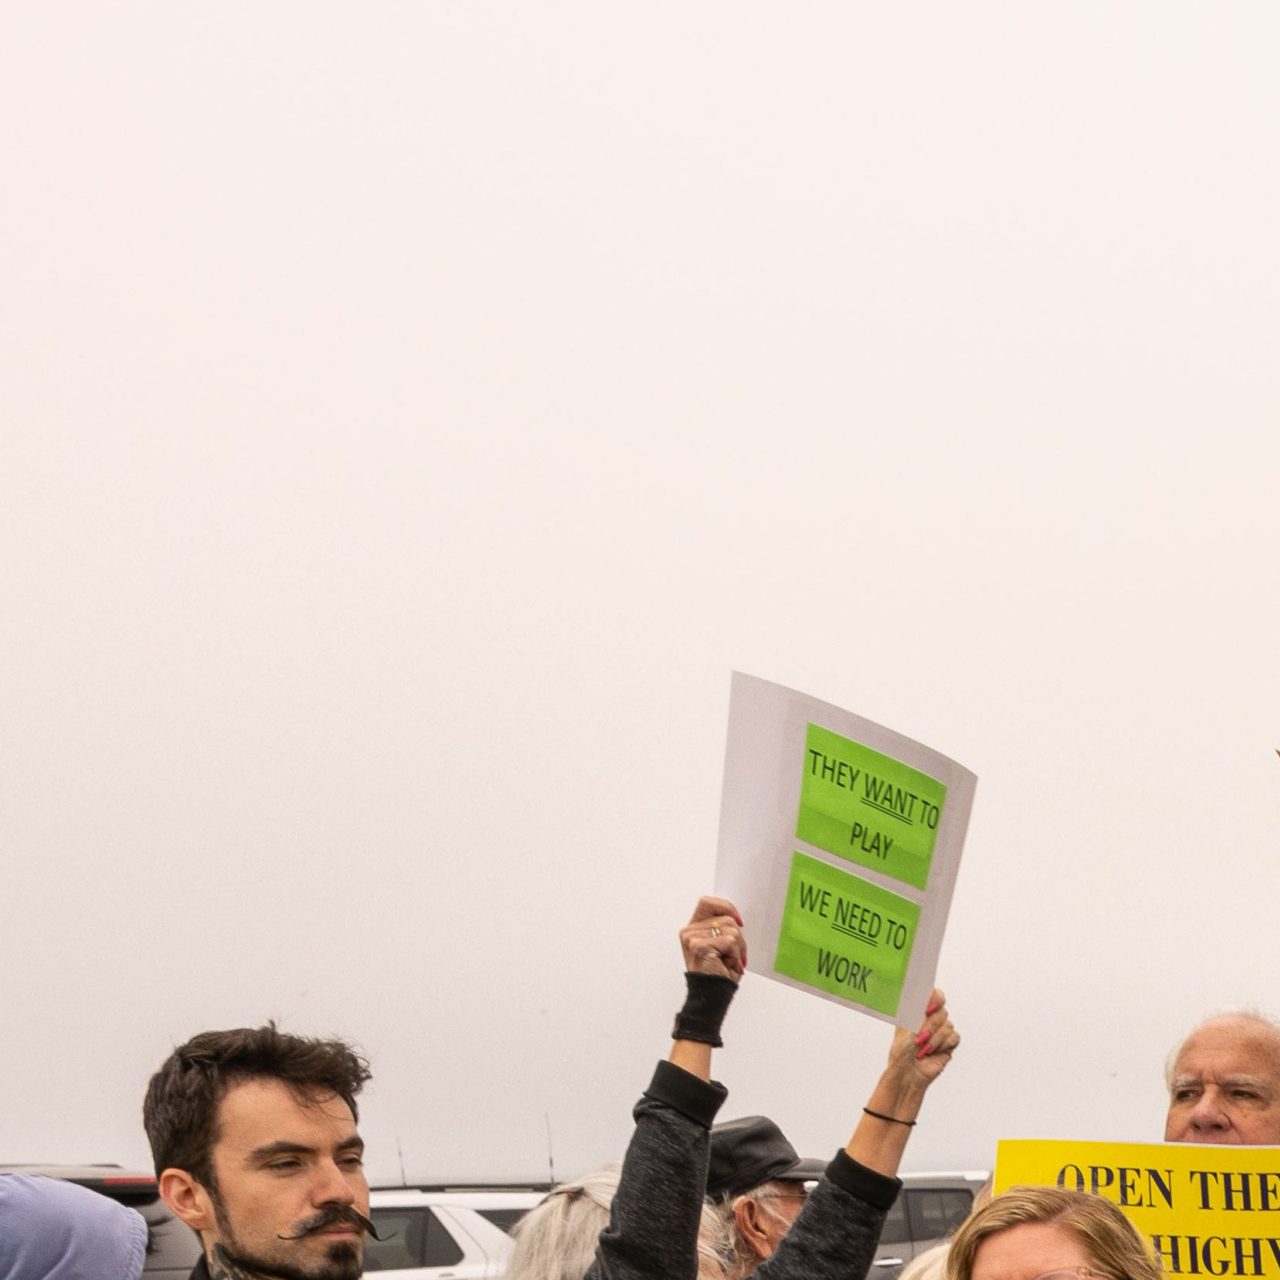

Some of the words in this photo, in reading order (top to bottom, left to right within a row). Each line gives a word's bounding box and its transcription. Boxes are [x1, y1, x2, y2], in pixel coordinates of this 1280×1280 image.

[809, 749, 861, 791] THEY
[864, 773, 918, 819] WANT
[921, 799, 939, 830] TO
[851, 822, 894, 860] PLAY
[800, 881, 831, 919] WE
[835, 897, 881, 941] NEED
[885, 919, 907, 950] TO
[818, 948, 873, 993] WORK
